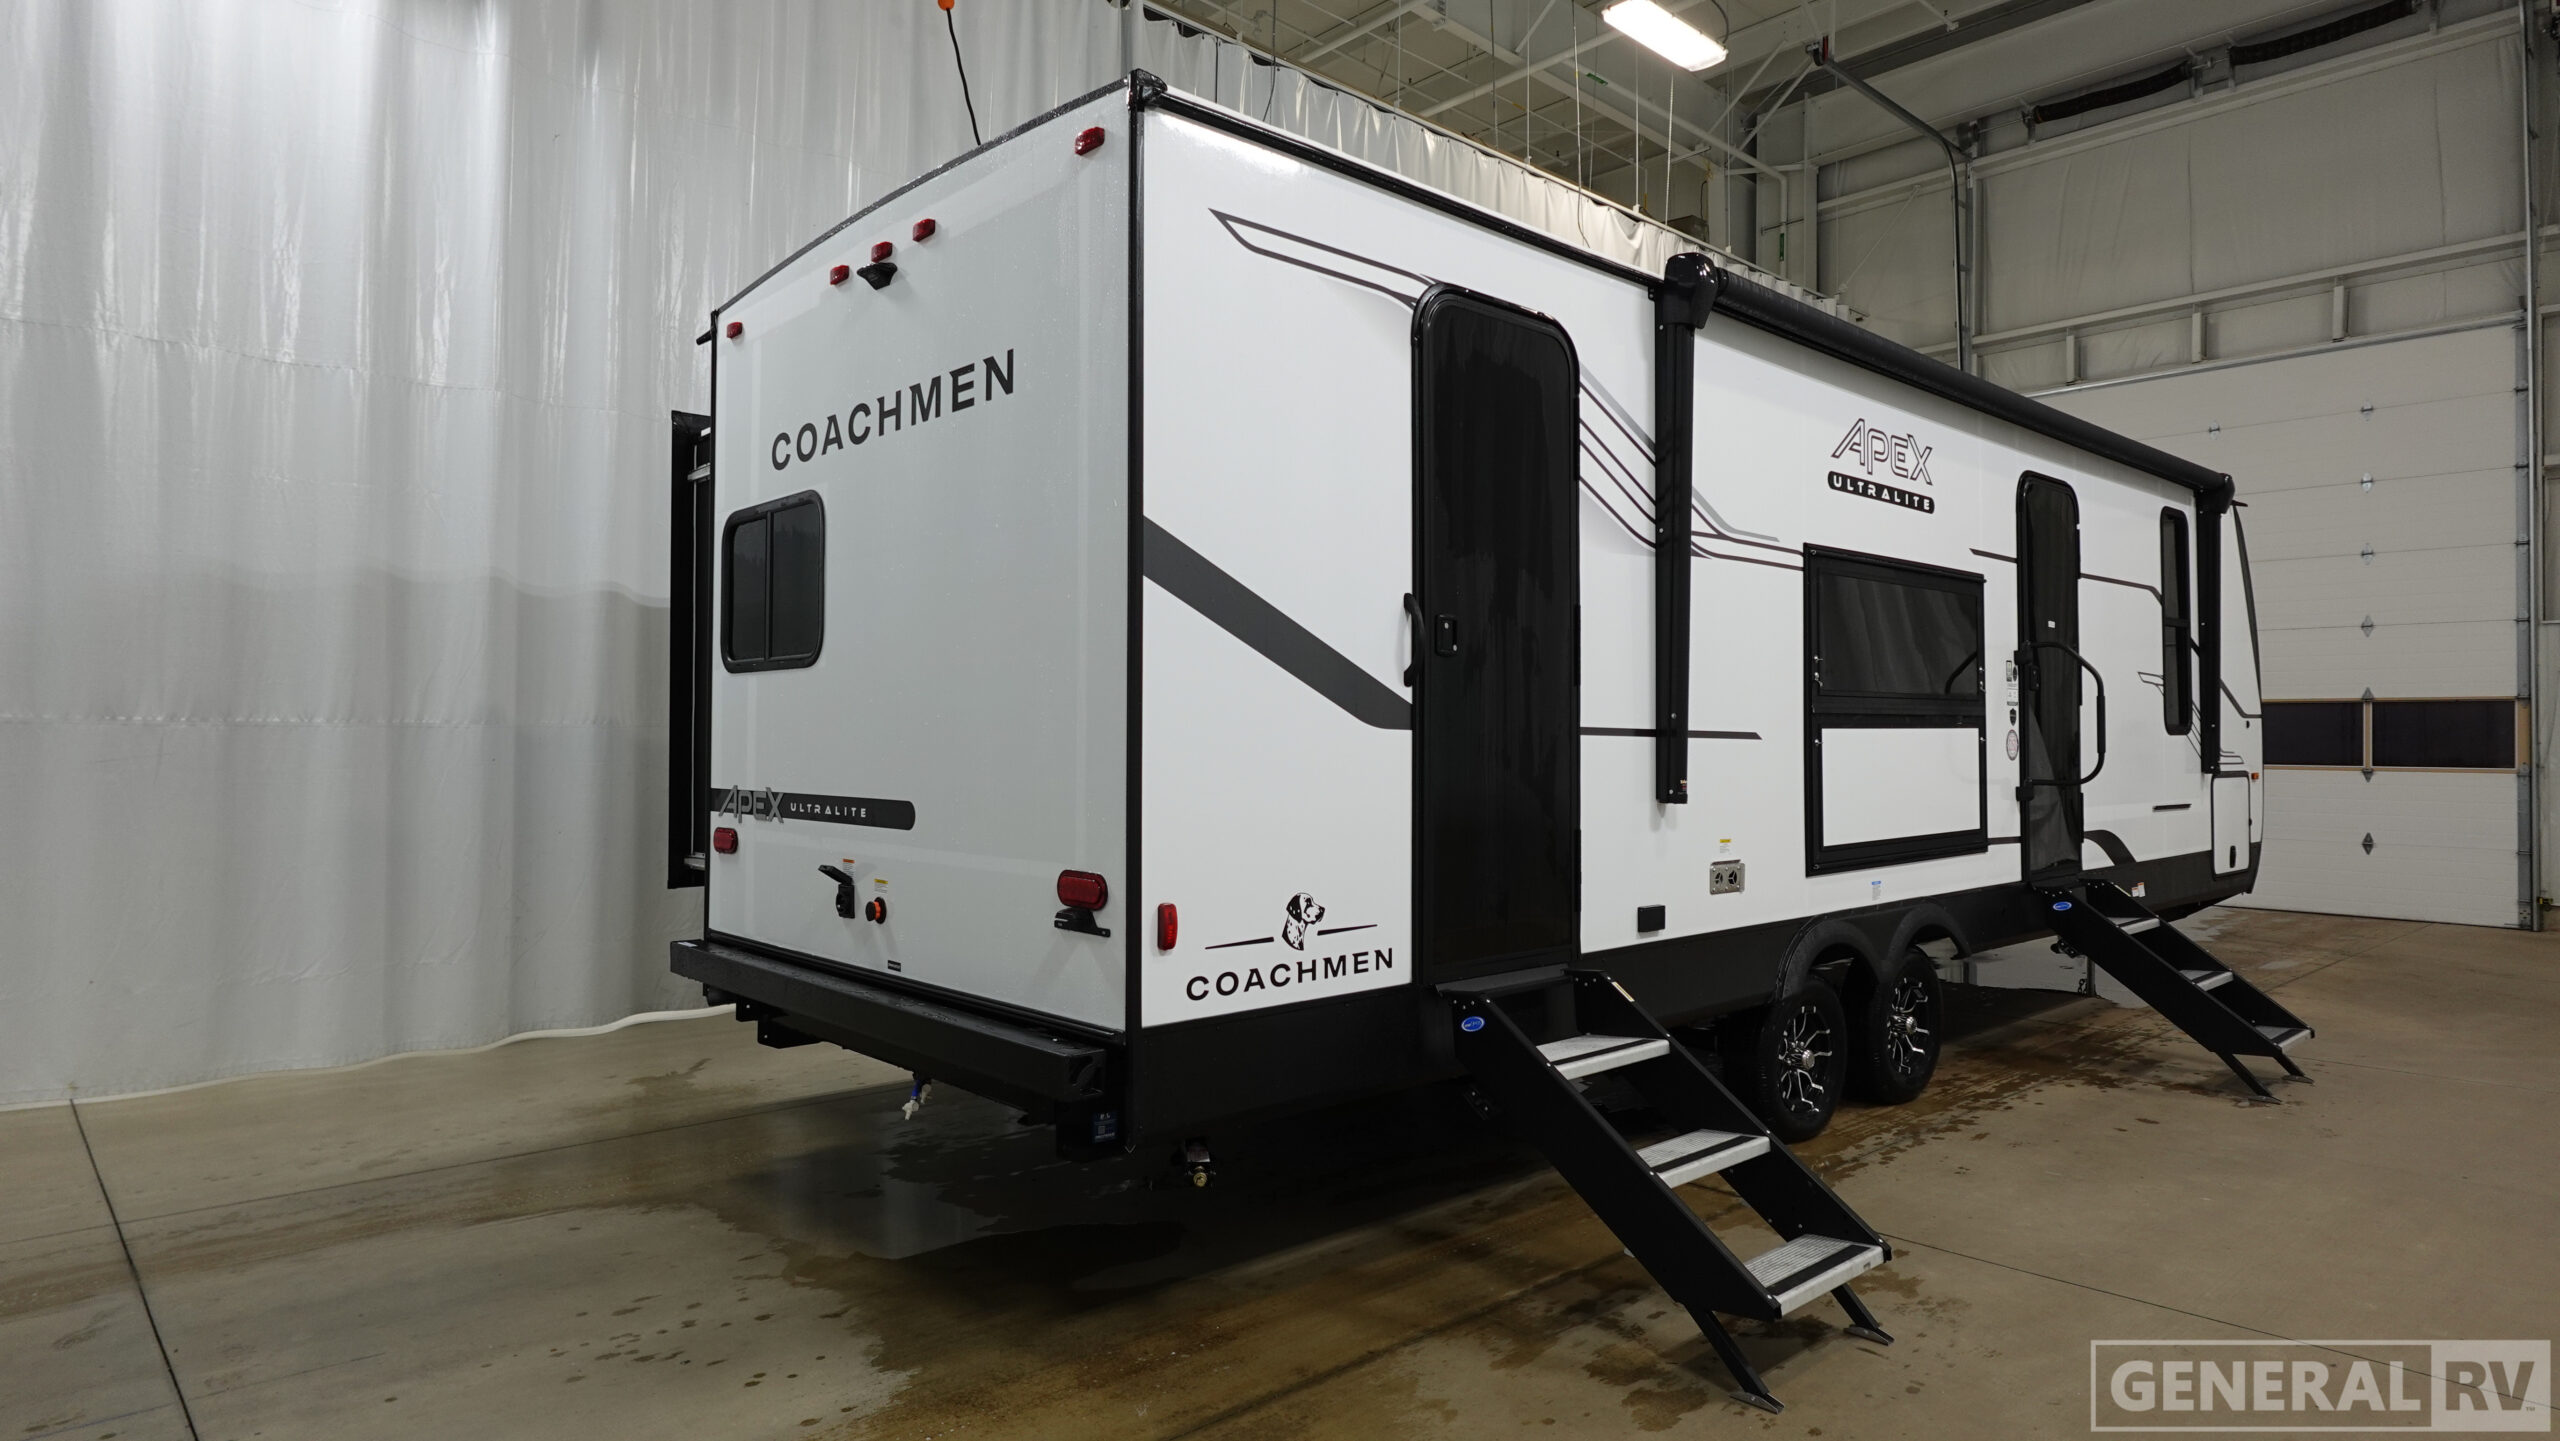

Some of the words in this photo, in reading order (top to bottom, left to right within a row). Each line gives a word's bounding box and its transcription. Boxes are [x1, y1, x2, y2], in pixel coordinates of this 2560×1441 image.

[771, 348, 1014, 471] COACHMEN
[1831, 417, 1933, 486] APEX
[1833, 474, 1930, 511] ULTRALITE
[718, 785, 784, 824] APEX
[790, 801, 867, 818] ULTRALITE
[1186, 947, 1393, 1001] COACHMEN
